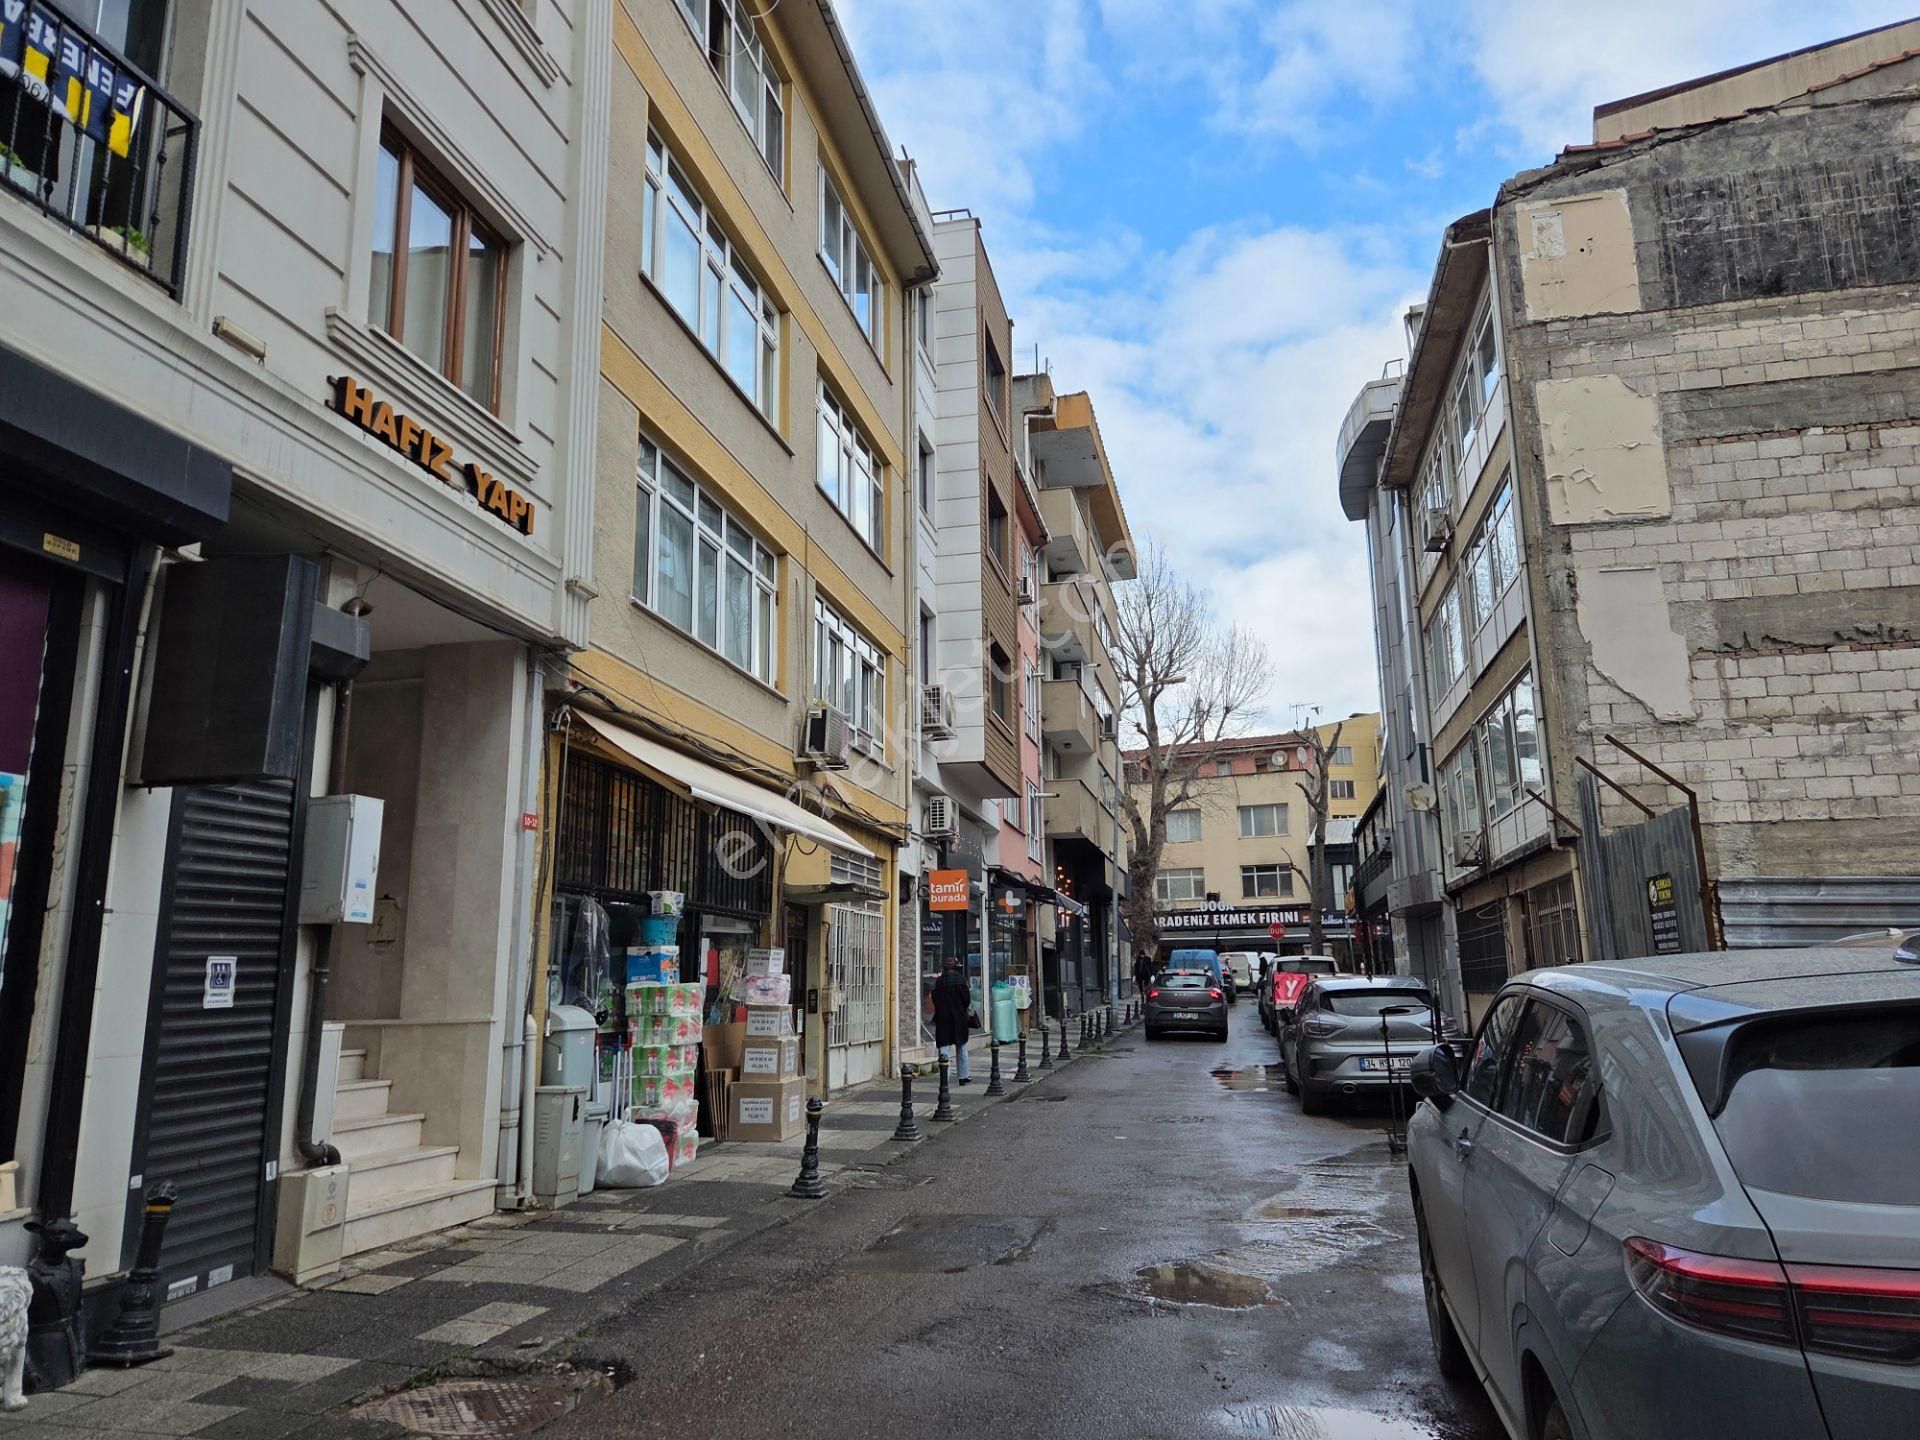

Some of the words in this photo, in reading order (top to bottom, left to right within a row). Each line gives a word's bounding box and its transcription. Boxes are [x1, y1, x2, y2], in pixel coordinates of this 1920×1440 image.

[338, 376, 453, 481] HAFIZ
[467, 463, 535, 536] YAPI
[930, 879, 965, 893] tamir
[931, 894, 966, 902] burada
[1213, 913, 1256, 925] EKMEK
[1260, 911, 1298, 923] FIRINI
[1365, 1058, 1376, 1067] 34
[1398, 1058, 1411, 1067] 120
